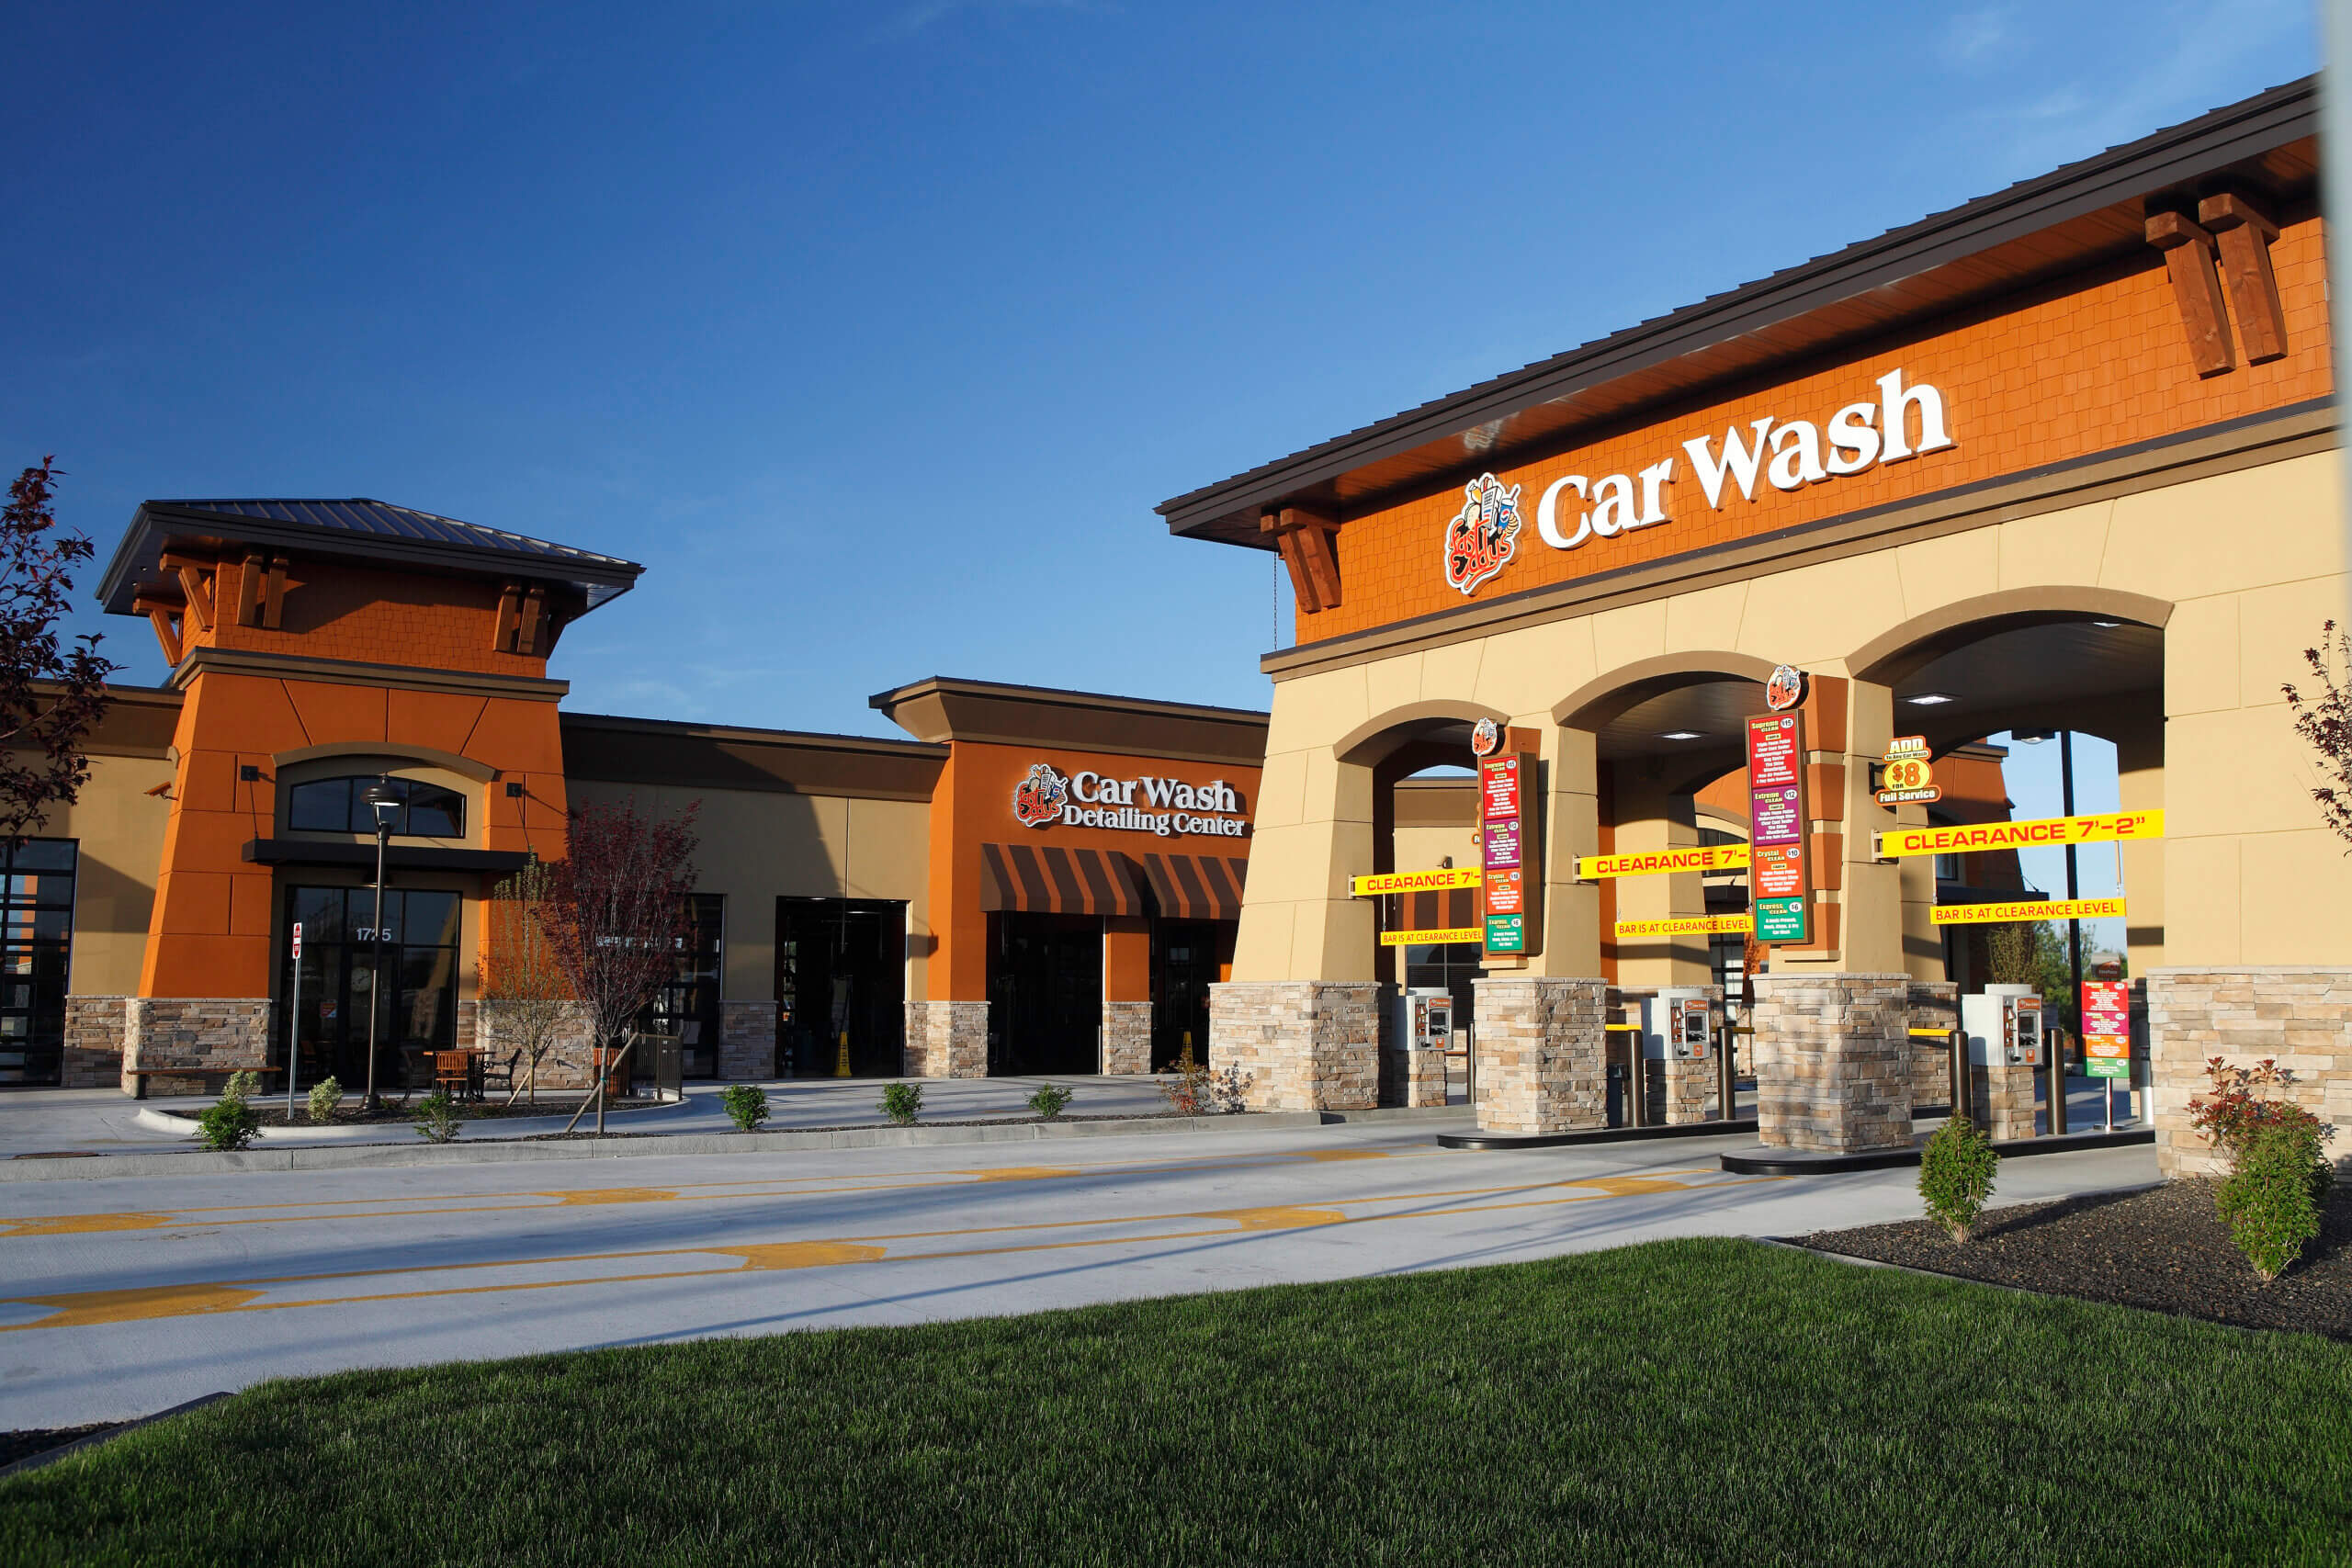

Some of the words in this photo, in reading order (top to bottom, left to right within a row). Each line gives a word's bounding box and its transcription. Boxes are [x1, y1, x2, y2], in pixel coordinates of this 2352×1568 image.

[1537, 457, 1674, 548] Car
[1682, 367, 1952, 509] Wash
[1889, 738, 1924, 754] ADD
[1893, 761, 1920, 787] $8
[1072, 771, 1138, 805] Car
[1138, 776, 1238, 812] Wash
[1880, 791, 1897, 803] Full
[1898, 788, 1936, 802] Service
[1062, 805, 1170, 836] Detailing
[1172, 812, 1245, 837] Center
[1904, 823, 2066, 851] CLEARANCE
[1596, 852, 1713, 874] CLEARANCE
[1721, 849, 1751, 864] 7'-
[1367, 873, 1456, 891] CLEARANCE
[1936, 908, 1960, 920] BAR
[1963, 908, 1973, 919] IS
[1977, 908, 1992, 919] AT
[1996, 904, 2073, 918] CLEARANCE
[2076, 902, 2118, 915] LEVEL
[1384, 934, 1397, 942] BAR
[1398, 933, 1405, 942] IS
[1407, 933, 1416, 942] AT
[1416, 932, 1458, 941] CLEARANCE
[1460, 931, 1483, 940] LEVEL
[1619, 924, 1636, 934] BAR
[1639, 924, 1646, 933] IS
[1649, 923, 1660, 932] AT
[1662, 920, 1718, 932] CLEARANCE
[1721, 919, 1750, 930] LEVEL
